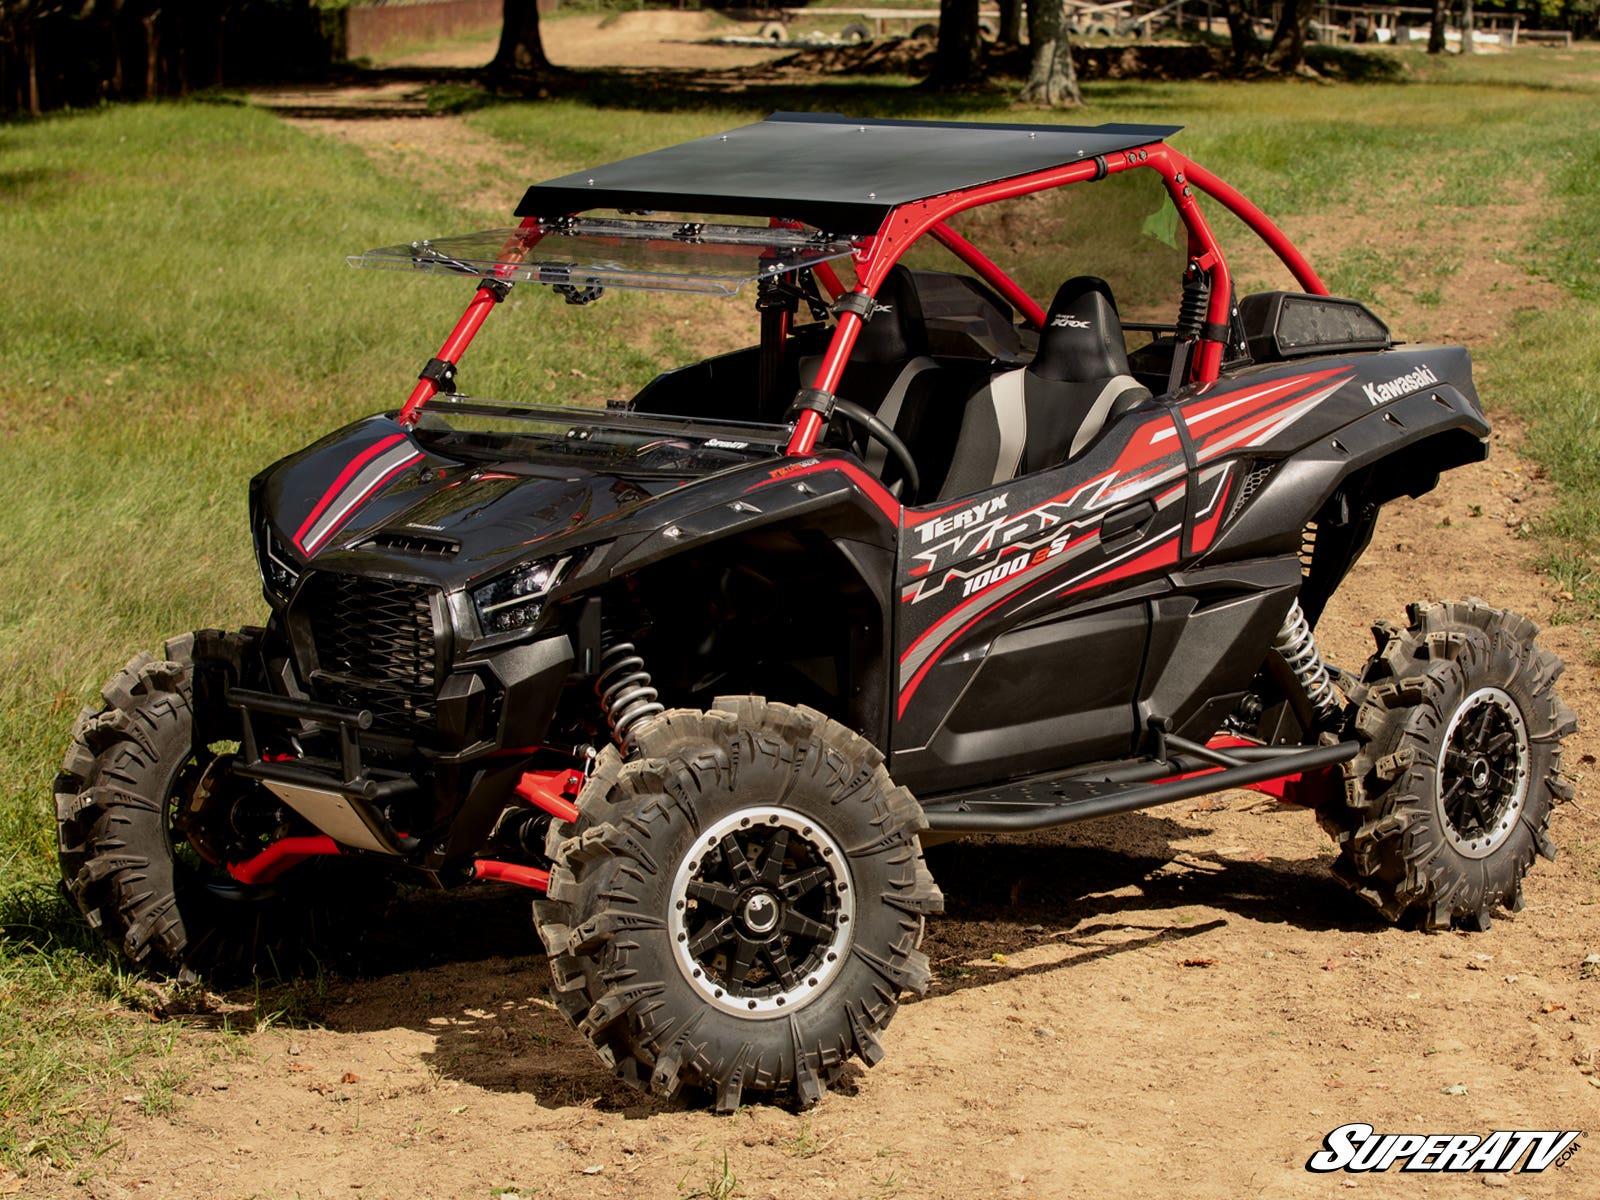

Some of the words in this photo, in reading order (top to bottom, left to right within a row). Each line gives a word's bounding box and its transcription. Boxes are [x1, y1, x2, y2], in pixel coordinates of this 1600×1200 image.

[1362, 364, 1438, 406] Kawasaki
[914, 493, 1009, 544] TERYX
[962, 552, 1031, 598] 1000
